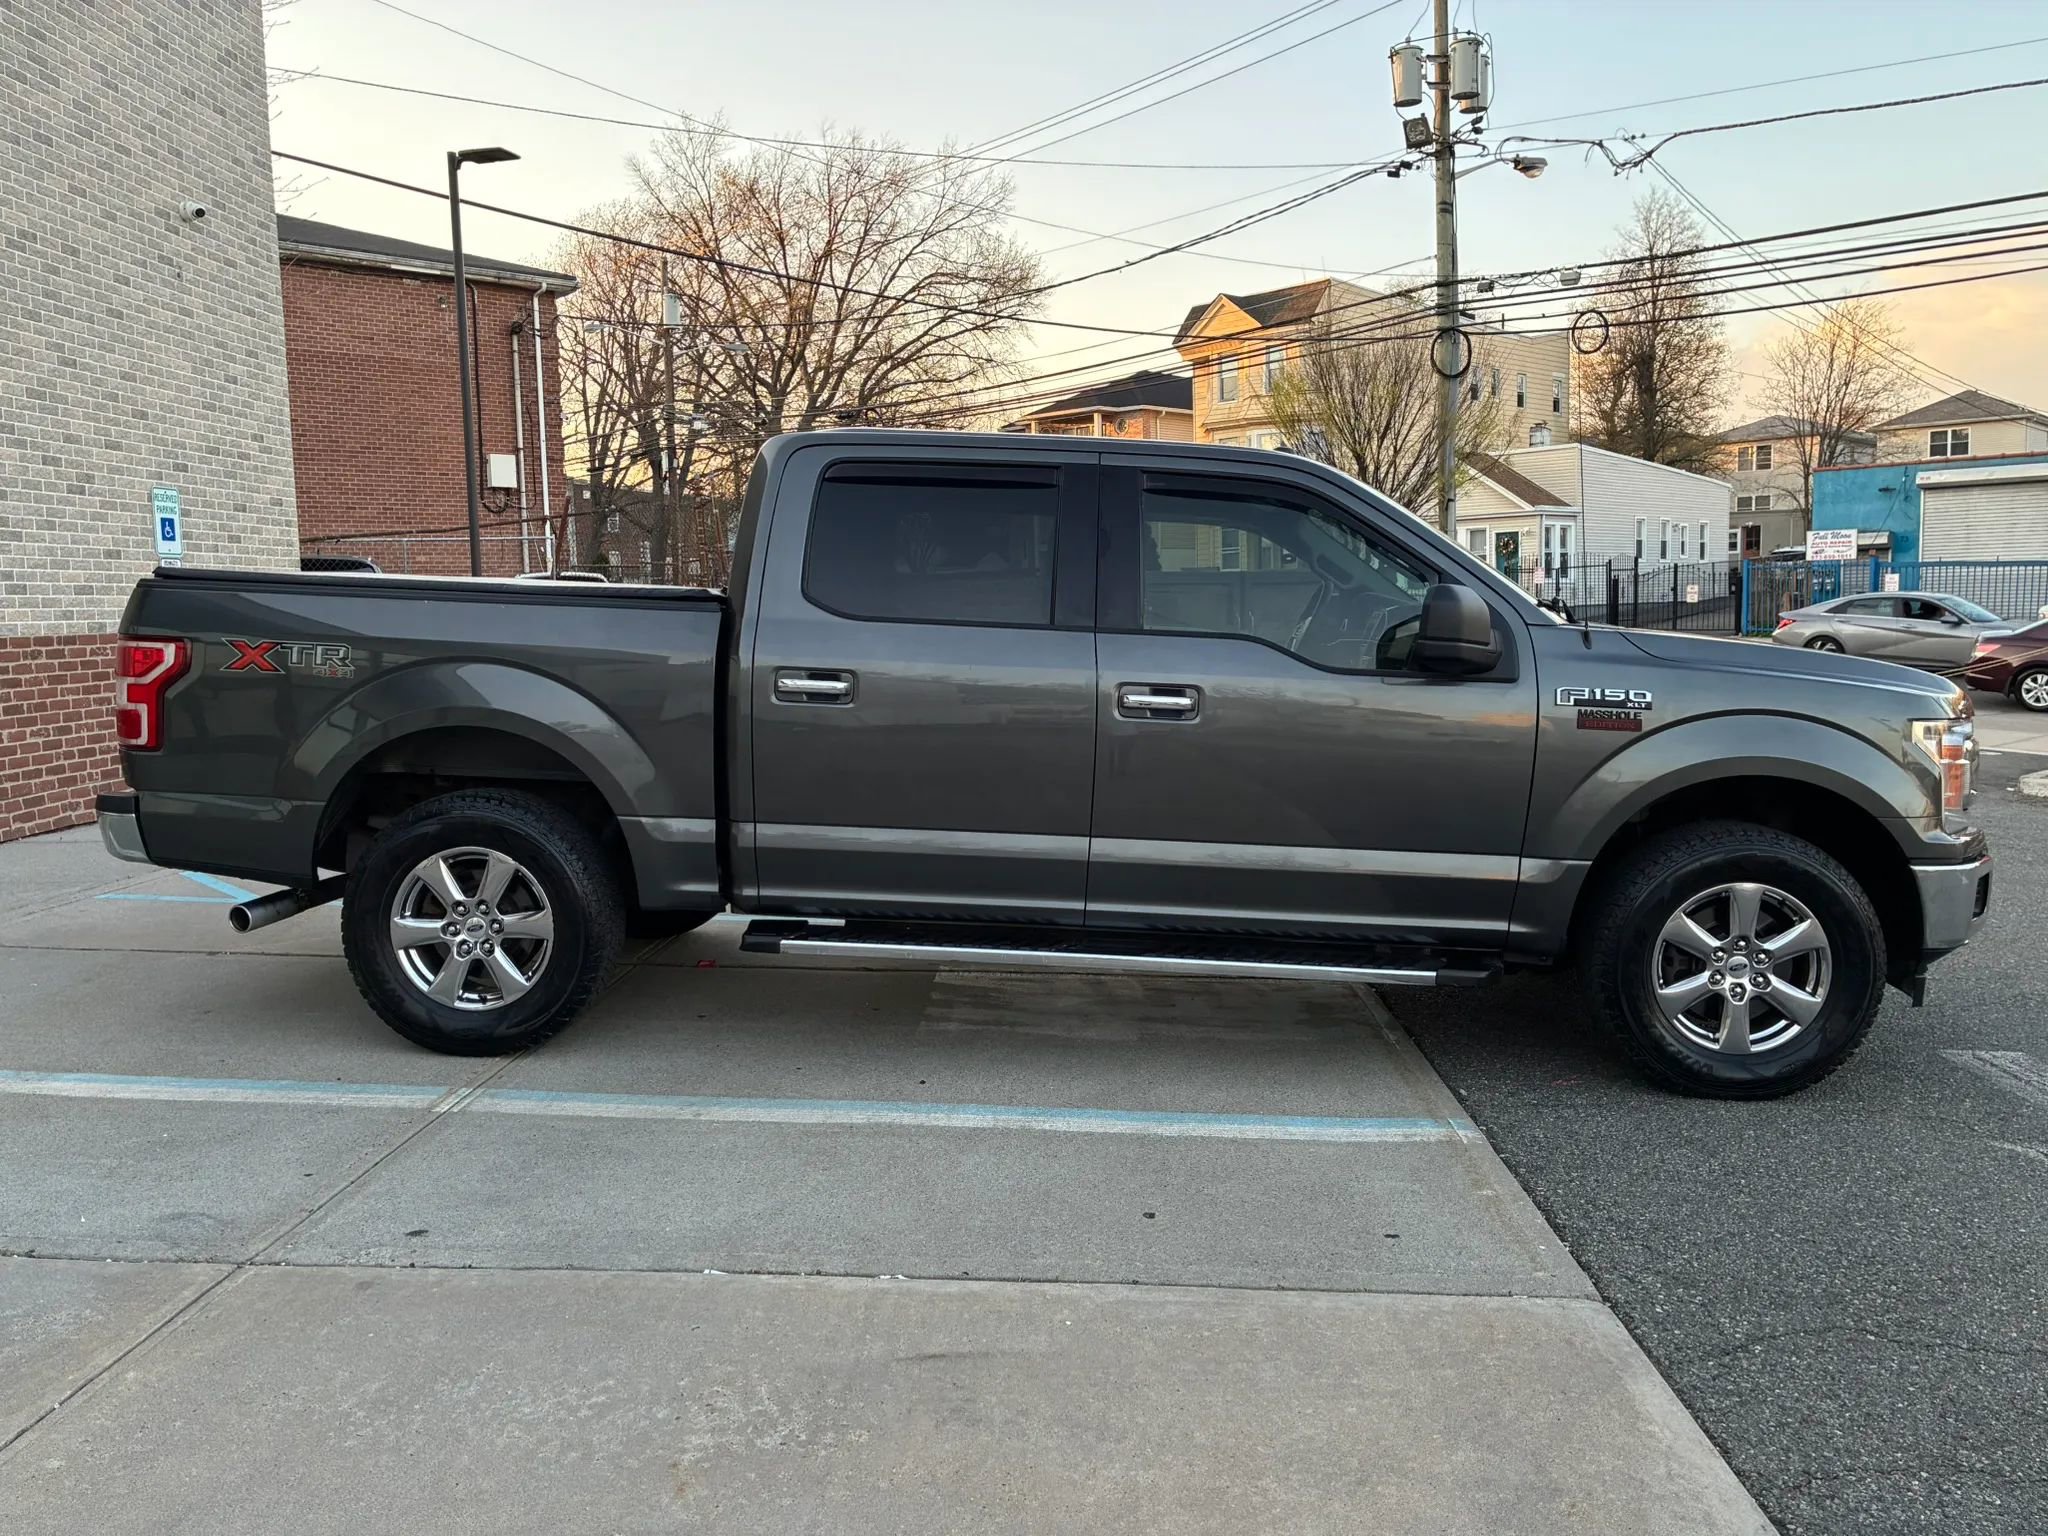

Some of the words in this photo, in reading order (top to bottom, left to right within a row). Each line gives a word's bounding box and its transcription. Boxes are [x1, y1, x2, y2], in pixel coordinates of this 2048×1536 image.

[154, 493, 177, 504] RESERVED
[156, 505, 177, 515] PARKING
[220, 637, 355, 675] XTR
[1577, 709, 1642, 720] MASSHOLE
[1584, 720, 1636, 729] EDITION
